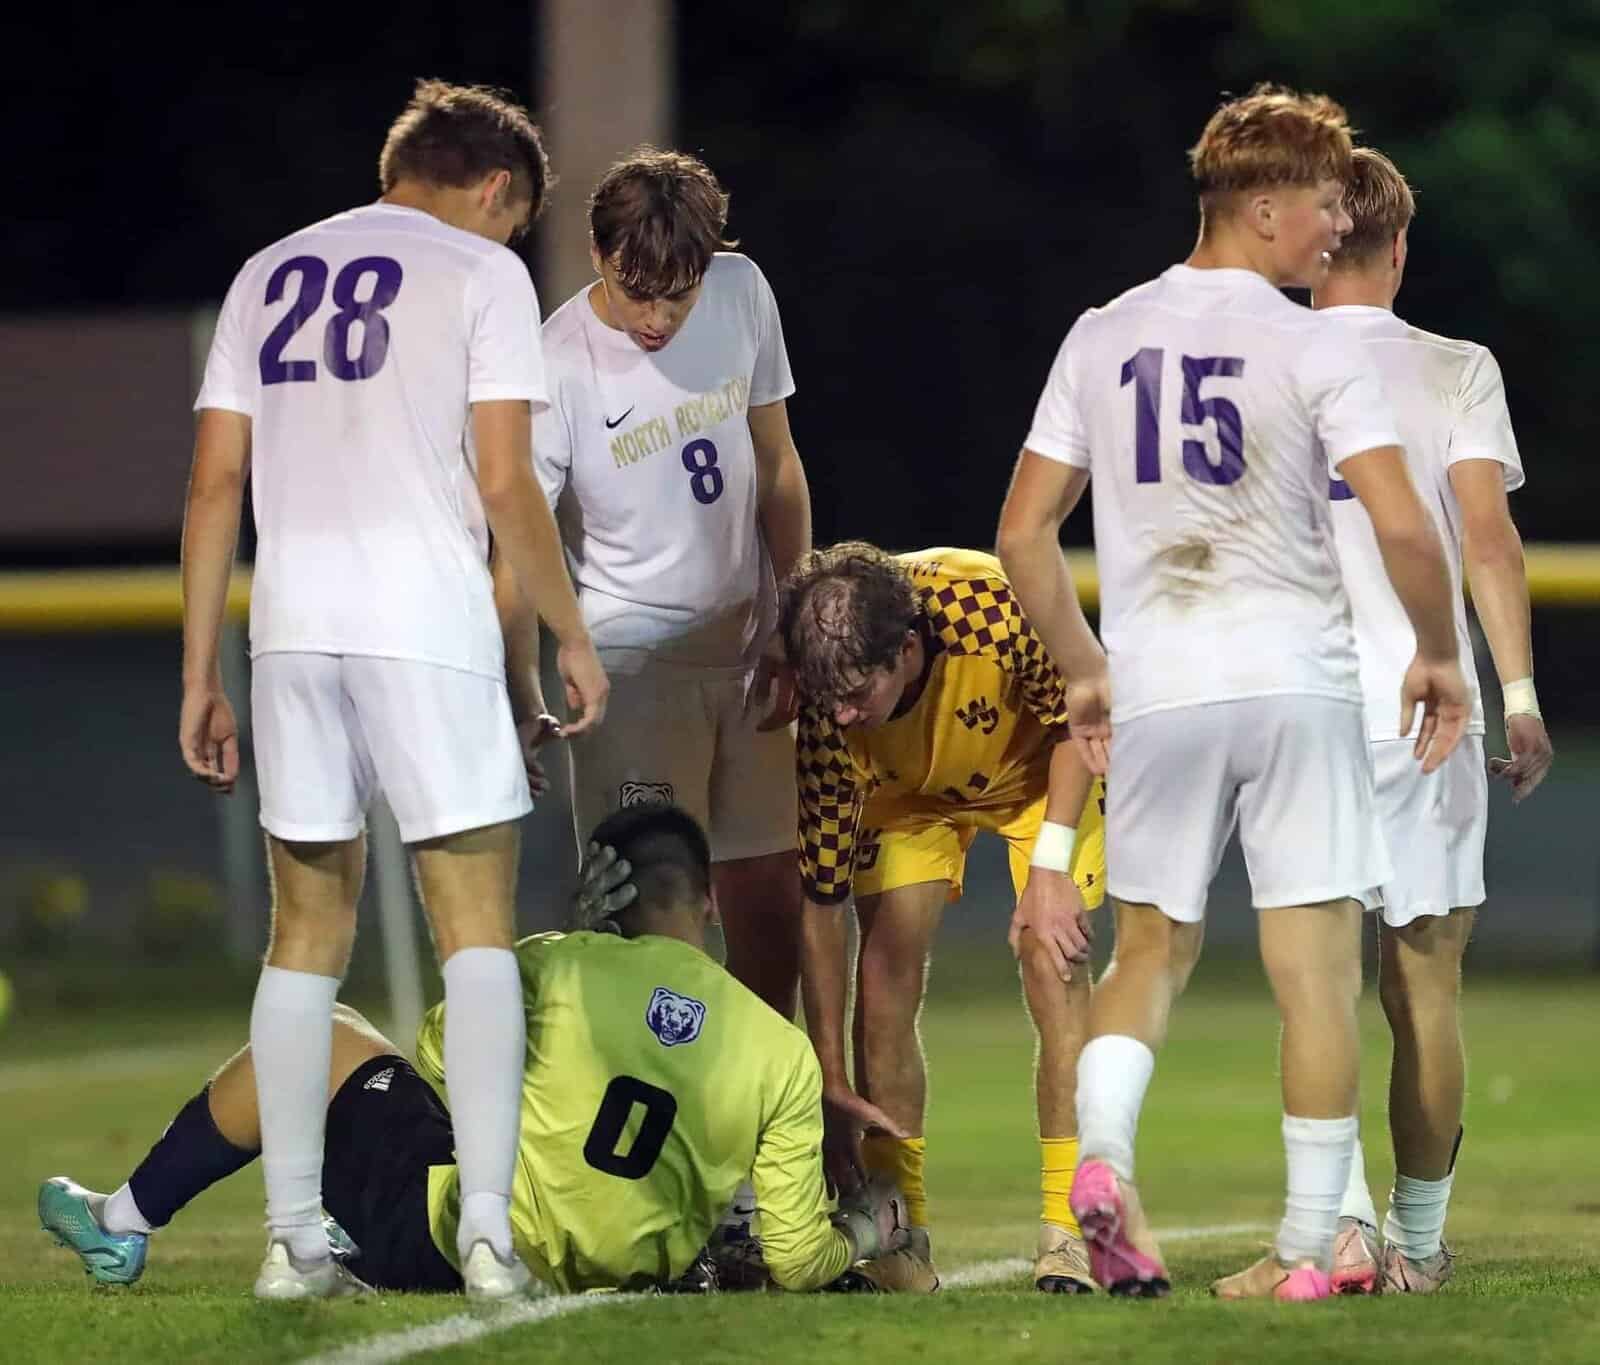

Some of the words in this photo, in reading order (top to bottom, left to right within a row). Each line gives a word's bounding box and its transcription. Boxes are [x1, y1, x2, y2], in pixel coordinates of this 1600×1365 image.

[259, 255, 403, 386] 28
[609, 415, 673, 469] NORTH
[1120, 347, 1248, 485] 15
[681, 438, 724, 504] 8
[583, 1075, 678, 1180] 0
